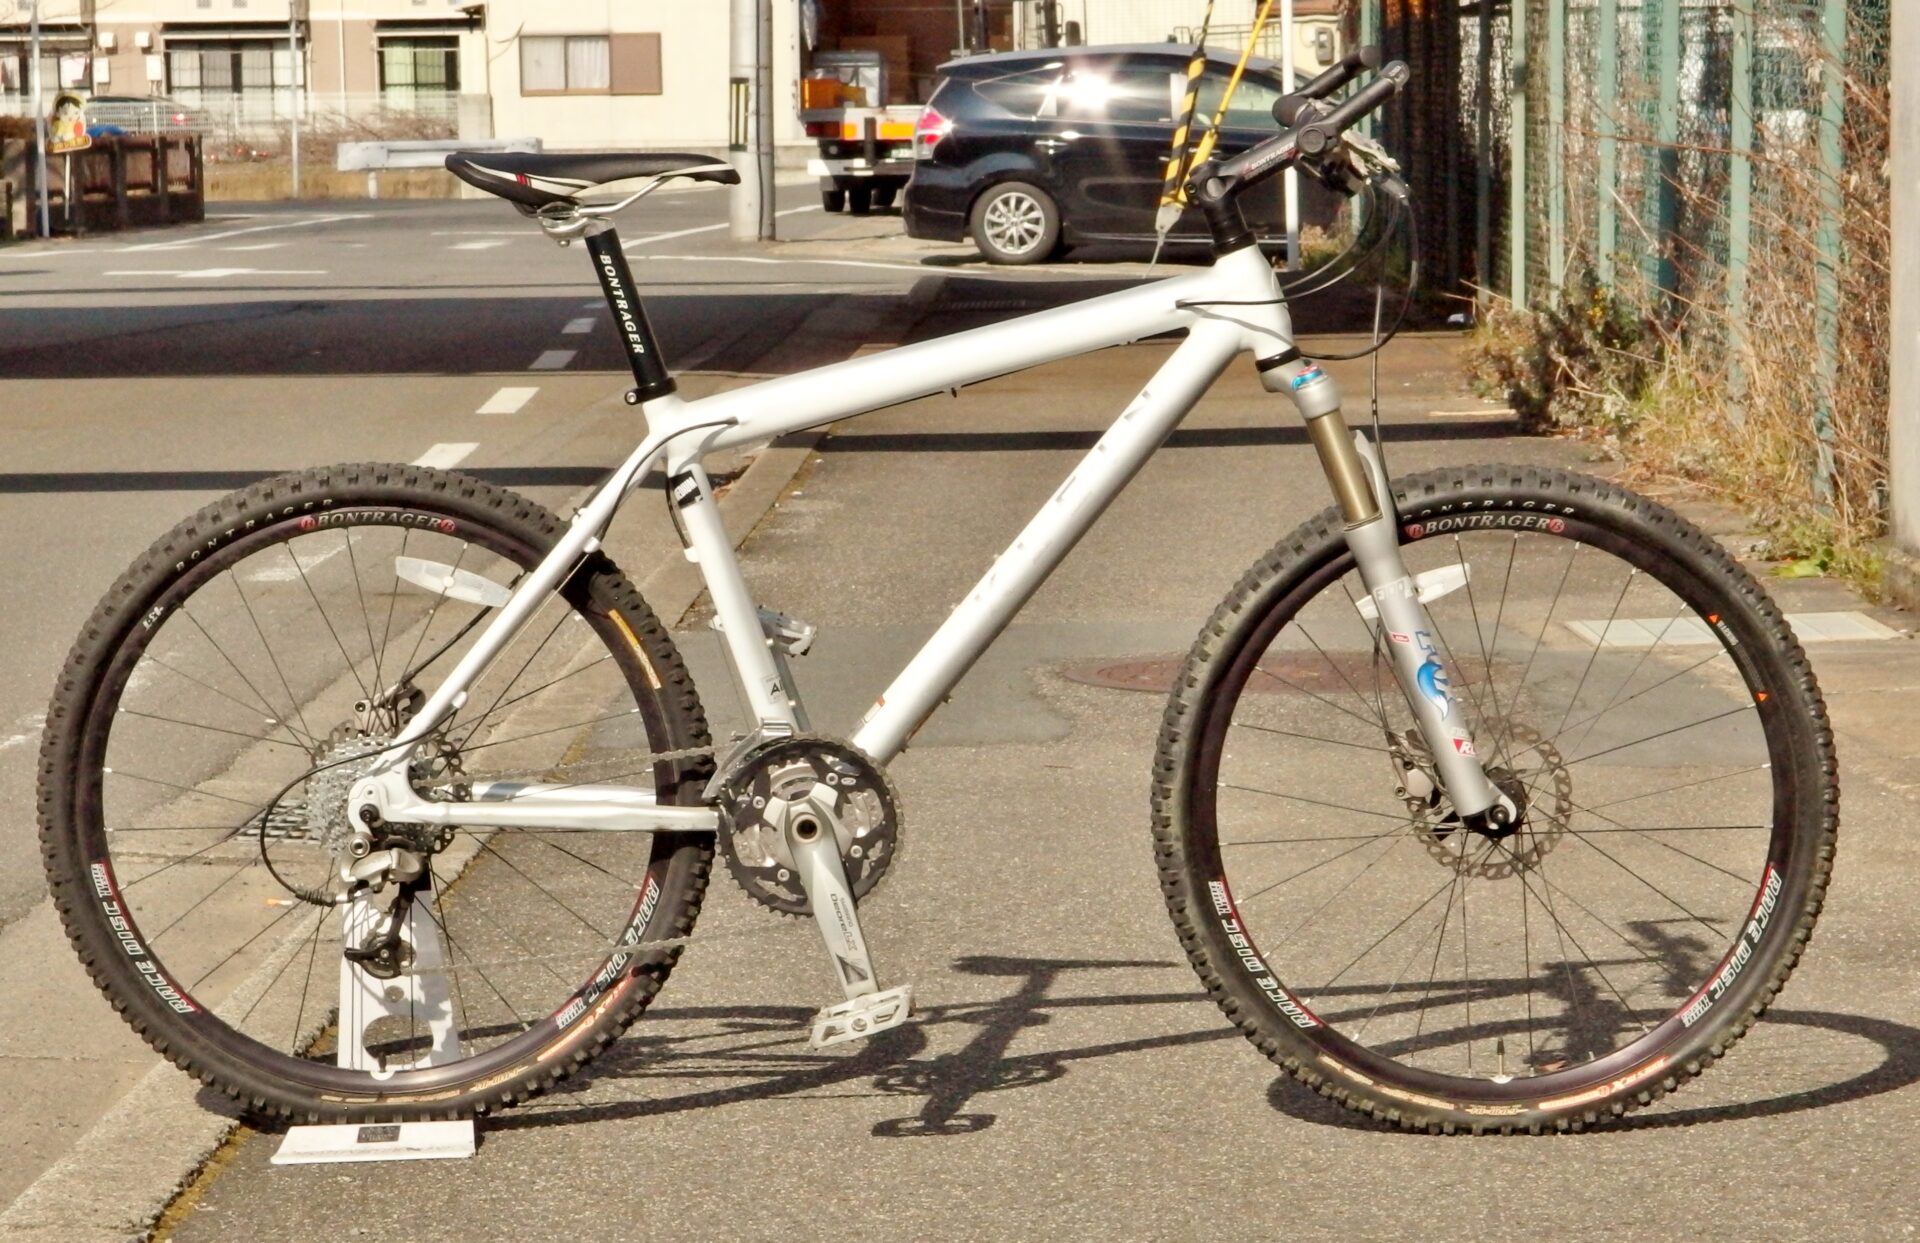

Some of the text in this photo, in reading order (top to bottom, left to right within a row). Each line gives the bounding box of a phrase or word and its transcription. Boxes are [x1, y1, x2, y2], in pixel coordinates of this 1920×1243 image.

[600, 254, 645, 354] BONTRAGER
[317, 511, 441, 528] BONTRAGER
[1425, 515, 1550, 534] BONTRAGER
[103, 901, 196, 1014] RACE DISC
[585, 877, 660, 1003] RACE DISC
[1221, 918, 1319, 1028] RACE DISC
[1709, 869, 1782, 1000] RACE DISC
